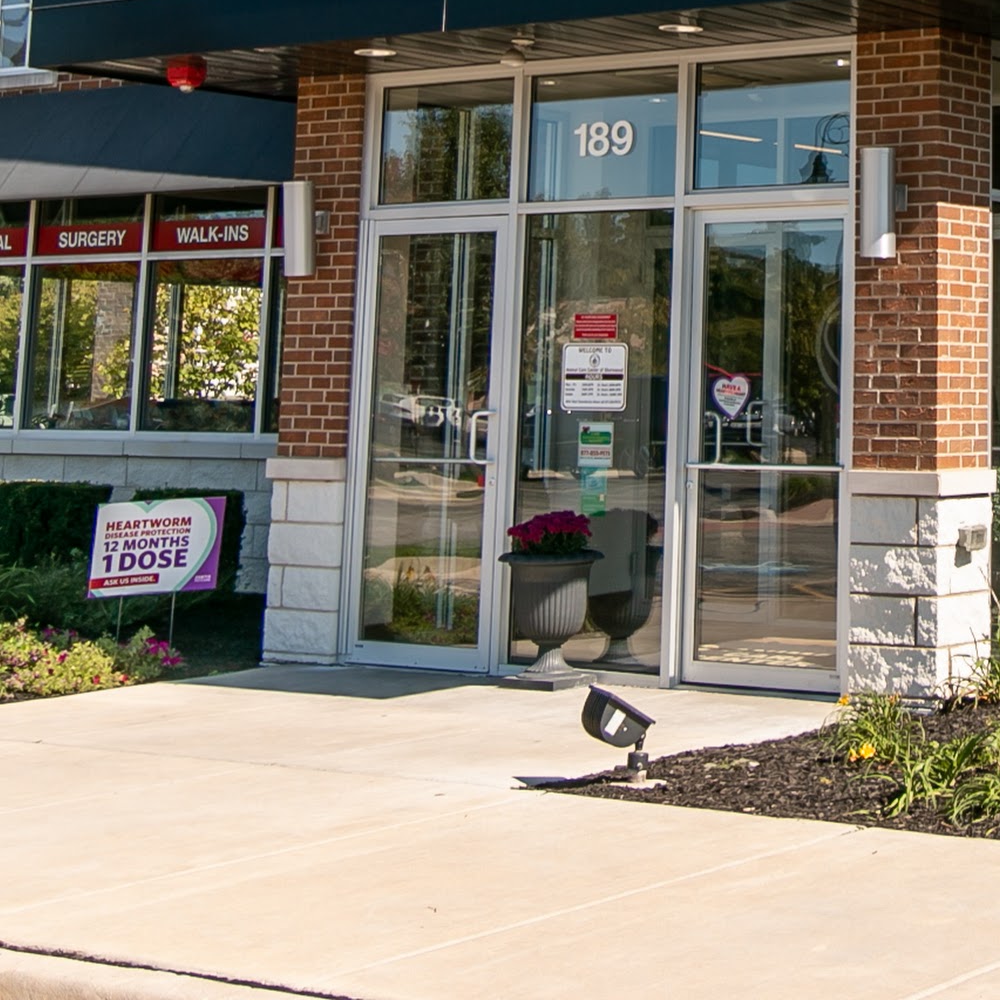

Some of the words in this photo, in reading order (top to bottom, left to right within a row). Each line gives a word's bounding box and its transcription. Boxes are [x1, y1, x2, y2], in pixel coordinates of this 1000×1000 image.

[574, 120, 635, 157] 189
[58, 229, 127, 248] SURGERY
[176, 224, 249, 244] WALK-INS
[106, 516, 192, 531] HEARTWORM
[104, 531, 139, 540] DISEASE
[140, 527, 191, 537] PROTECTION
[103, 541, 119, 552] 12
[122, 535, 190, 552] MONTHS
[102, 553, 114, 573] 1
[118, 548, 188, 572] DOSE
[103, 578, 118, 586] ASK
[120, 577, 130, 585] US
